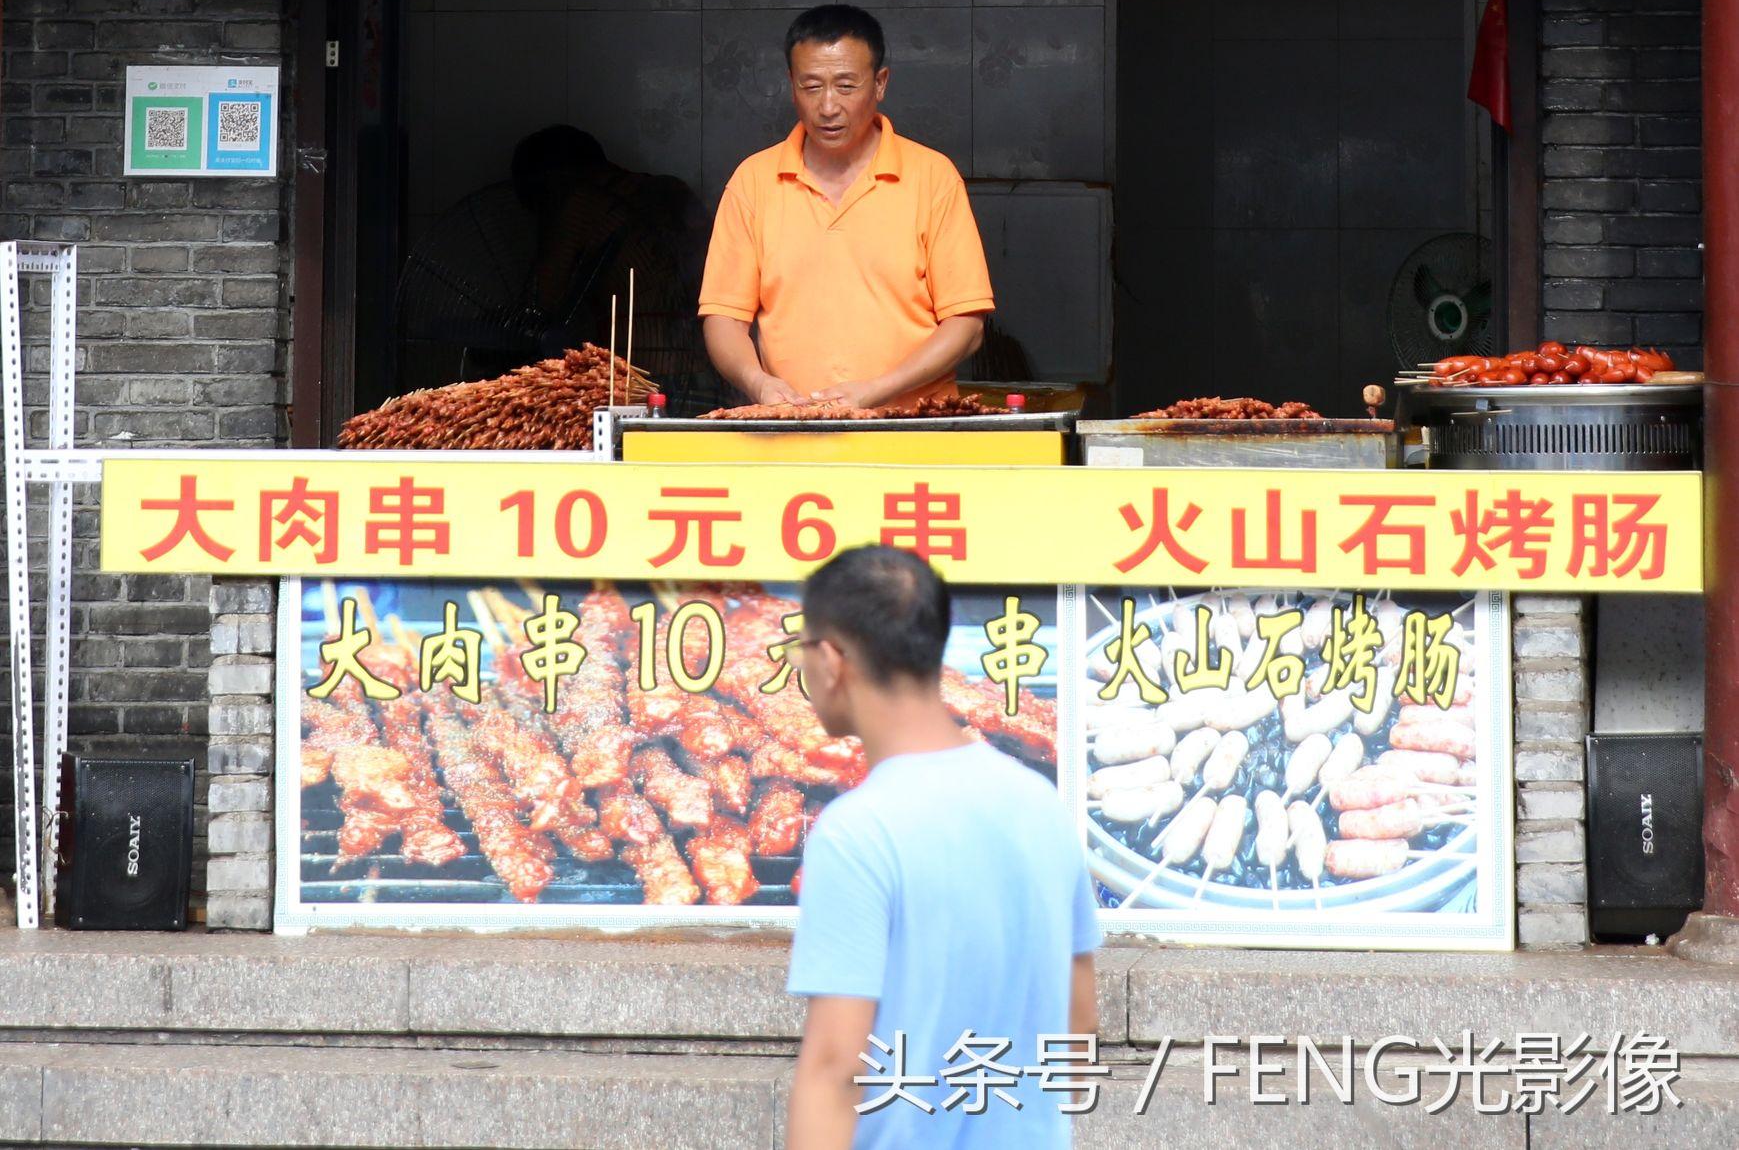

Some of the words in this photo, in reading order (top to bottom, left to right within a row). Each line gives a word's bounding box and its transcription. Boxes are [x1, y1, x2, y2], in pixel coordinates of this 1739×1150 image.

[140, 475, 968, 568] 大肉串10元6串
[1114, 487, 1668, 581] 火山石烤肠
[1098, 593, 1464, 716] 火山石烤肠
[127, 815, 141, 875] SOAIY
[1640, 793, 1654, 854] SOAIY
